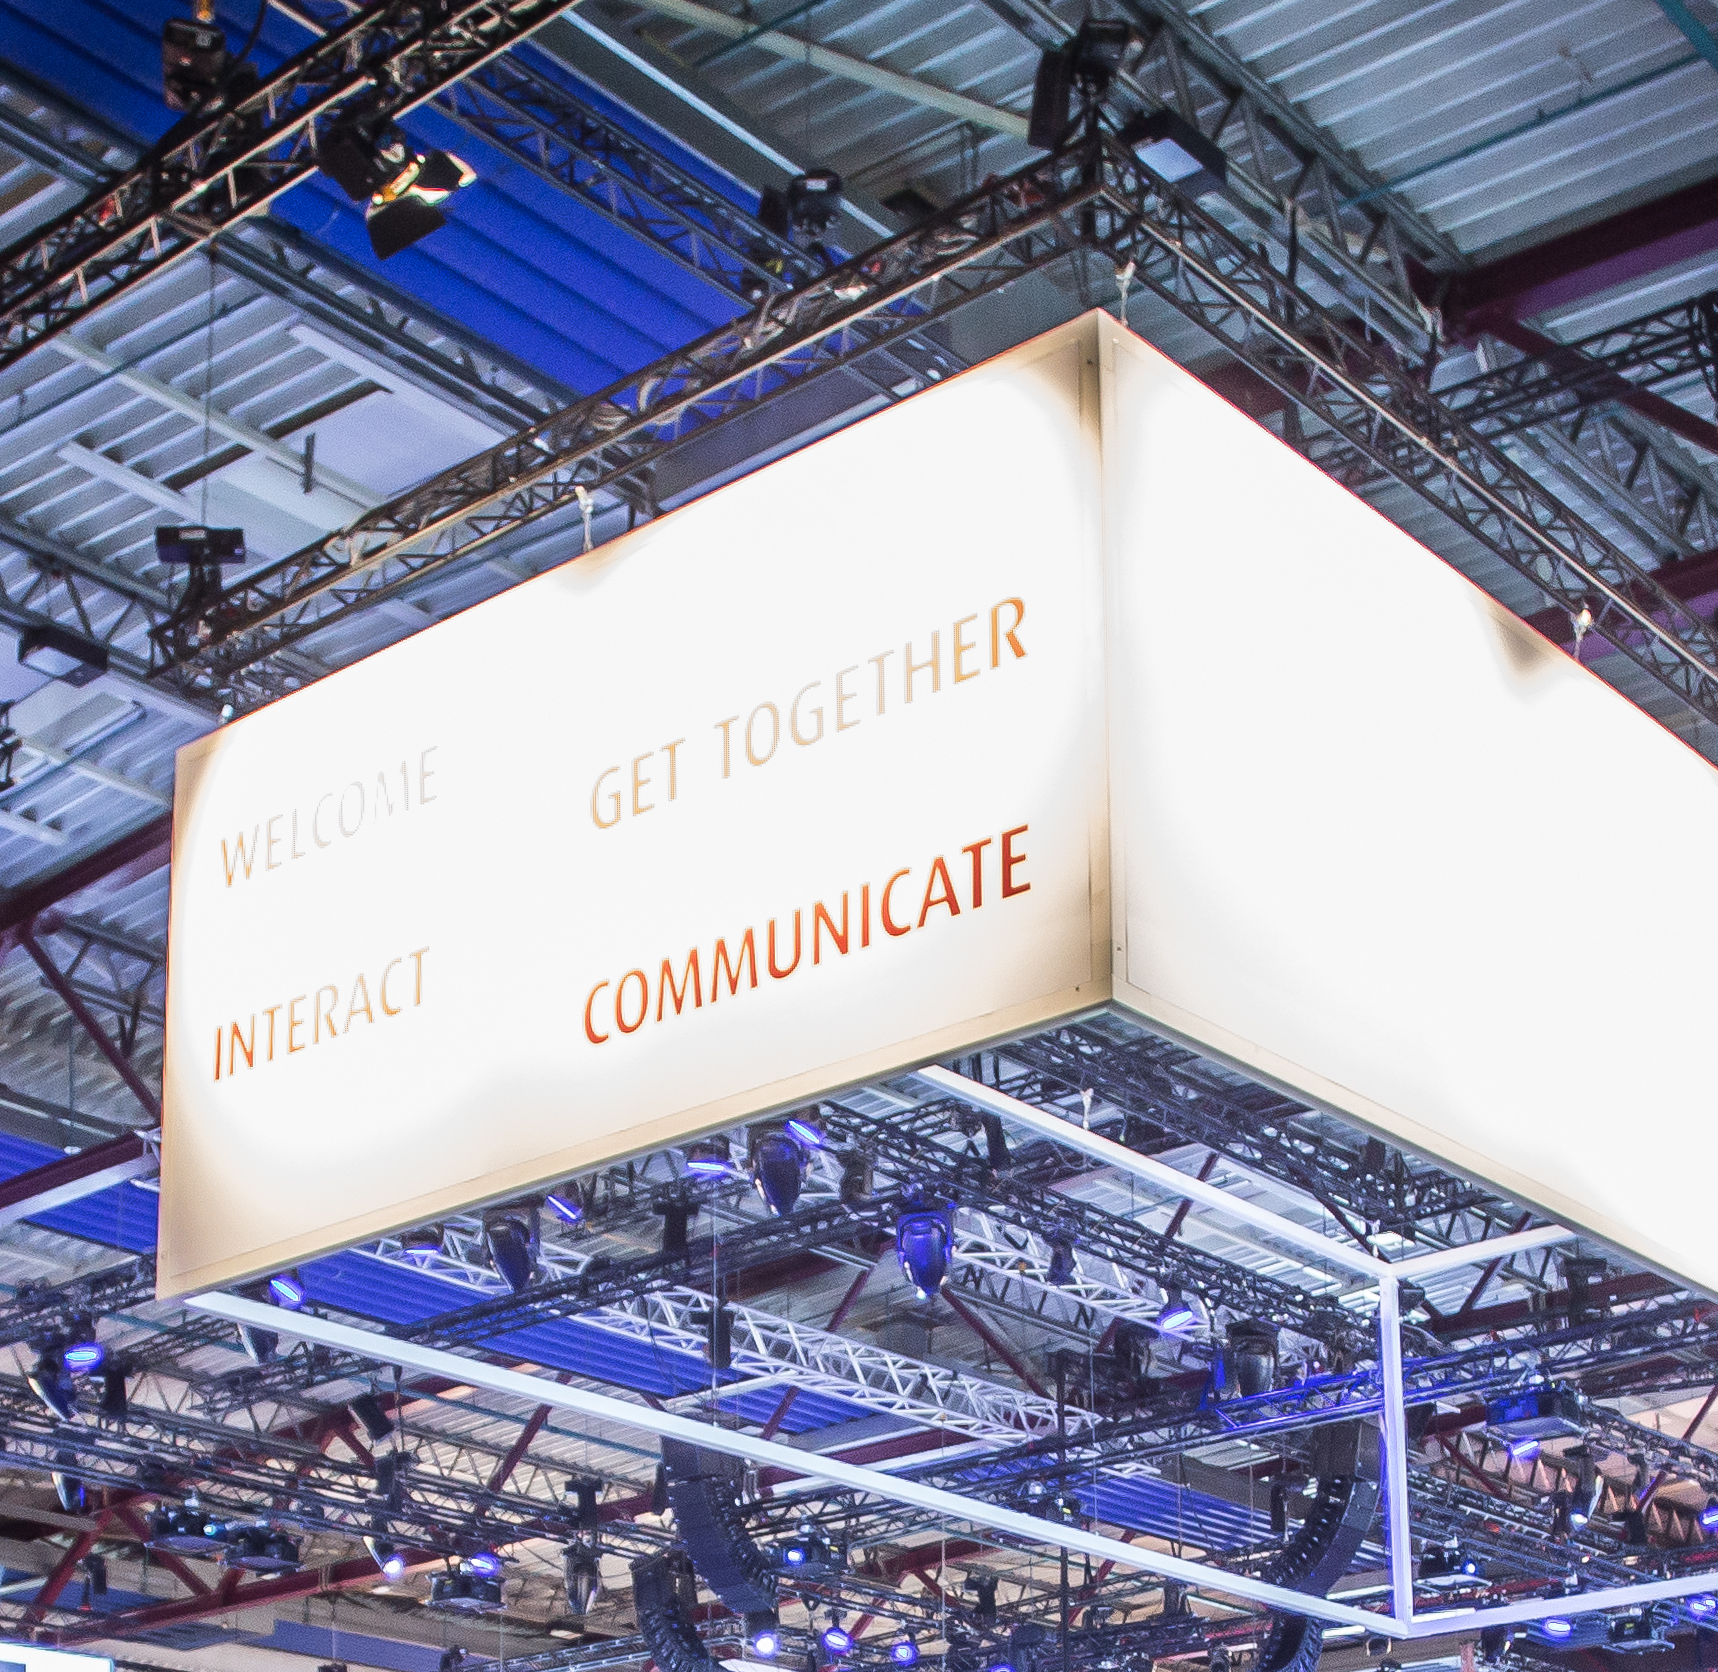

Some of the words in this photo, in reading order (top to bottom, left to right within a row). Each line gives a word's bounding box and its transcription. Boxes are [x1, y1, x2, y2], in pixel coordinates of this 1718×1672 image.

[587, 737, 686, 831] GET
[714, 596, 1029, 780] TOGETHER
[220, 745, 439, 888] WELCOME
[212, 945, 432, 1083] INTERACT
[583, 824, 1033, 1046] COMMUNICATE
